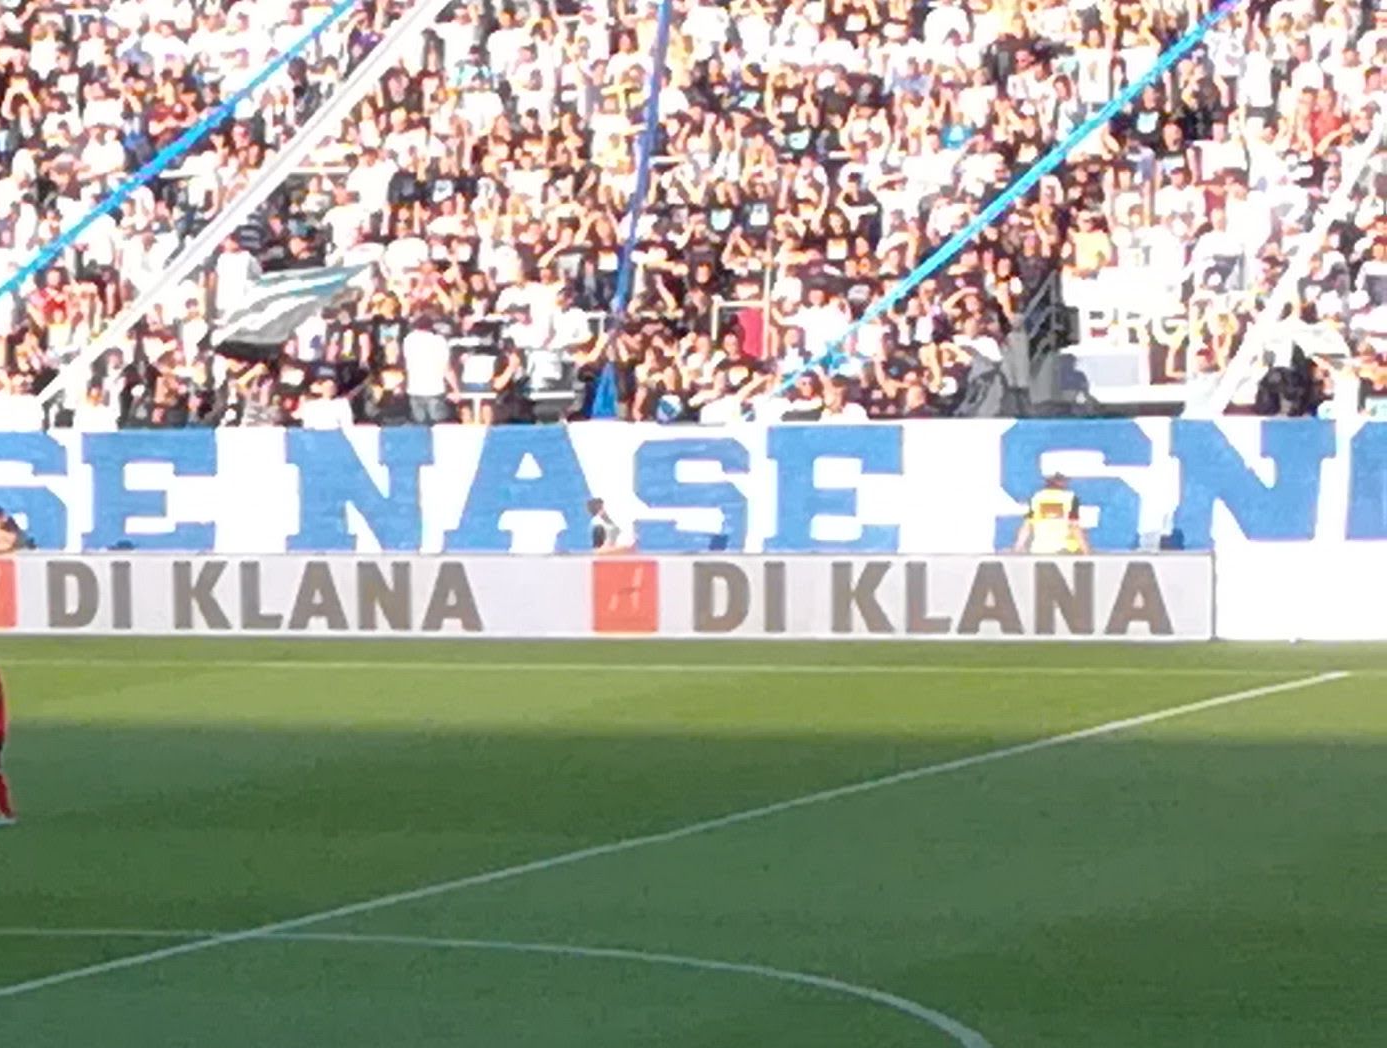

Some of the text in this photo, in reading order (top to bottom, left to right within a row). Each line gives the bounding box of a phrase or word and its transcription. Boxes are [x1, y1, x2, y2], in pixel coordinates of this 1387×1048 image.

[286, 424, 904, 551] NASE
[46, 560, 484, 632] DI KLANA
[692, 561, 1173, 634] DI KLANA
